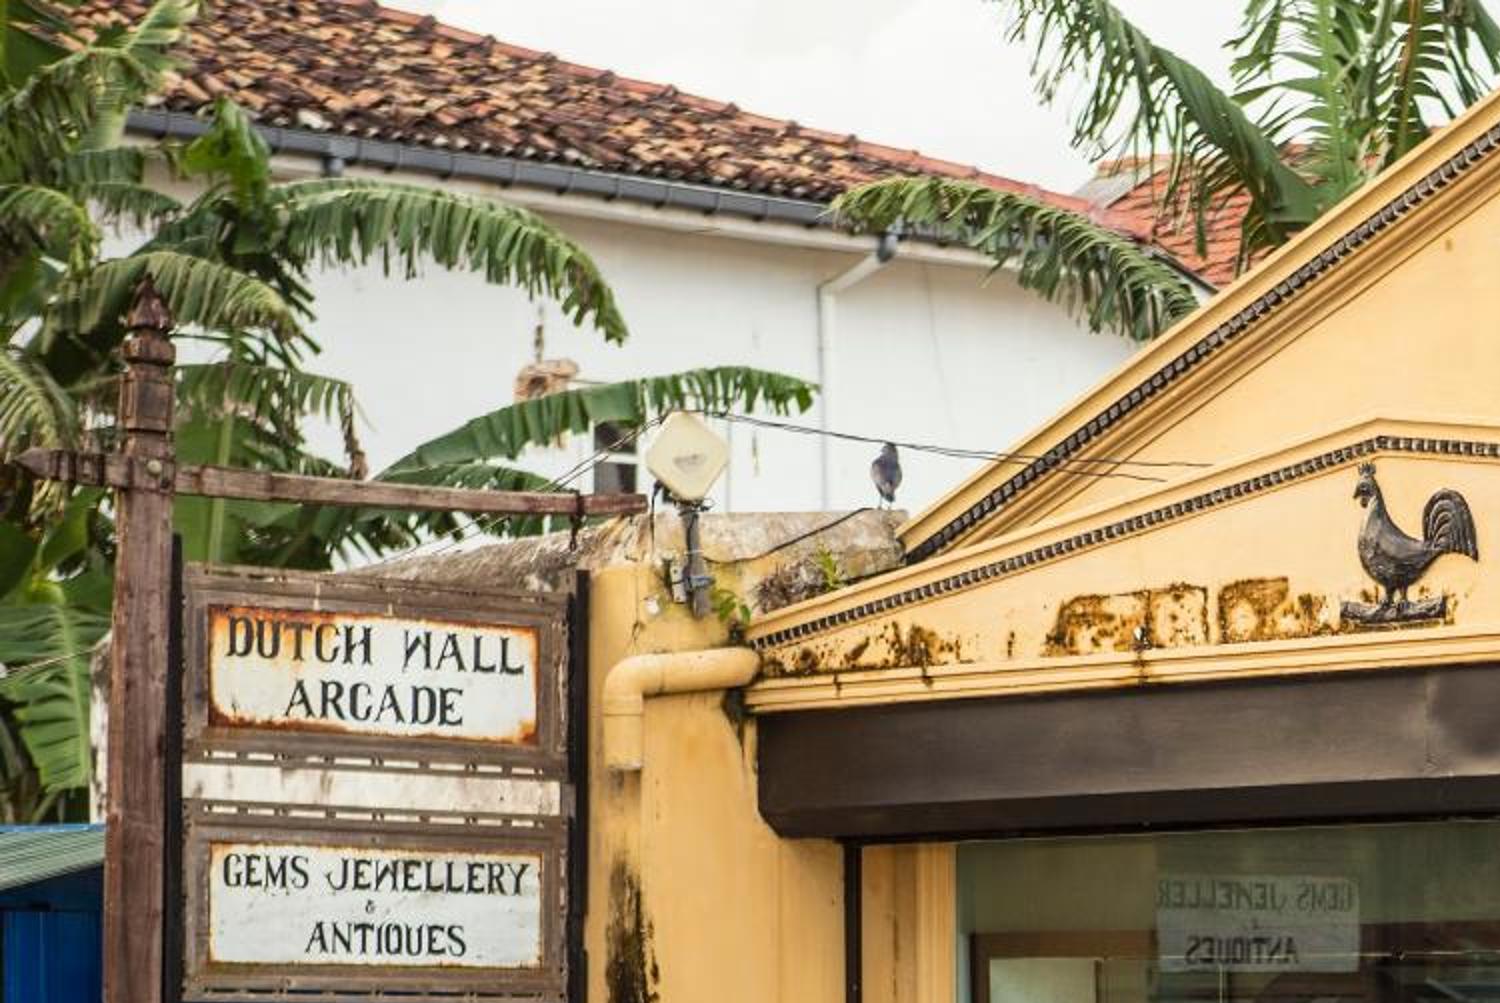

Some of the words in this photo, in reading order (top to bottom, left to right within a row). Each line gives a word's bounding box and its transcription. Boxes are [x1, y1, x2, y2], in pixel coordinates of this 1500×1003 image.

[225, 615, 372, 665] DUTCH
[402, 629, 525, 676] WALL
[284, 680, 463, 727] ARCADE
[222, 853, 309, 891] GEMS
[325, 857, 530, 895] JEWELLERY
[304, 921, 466, 958] ANTIQUES
